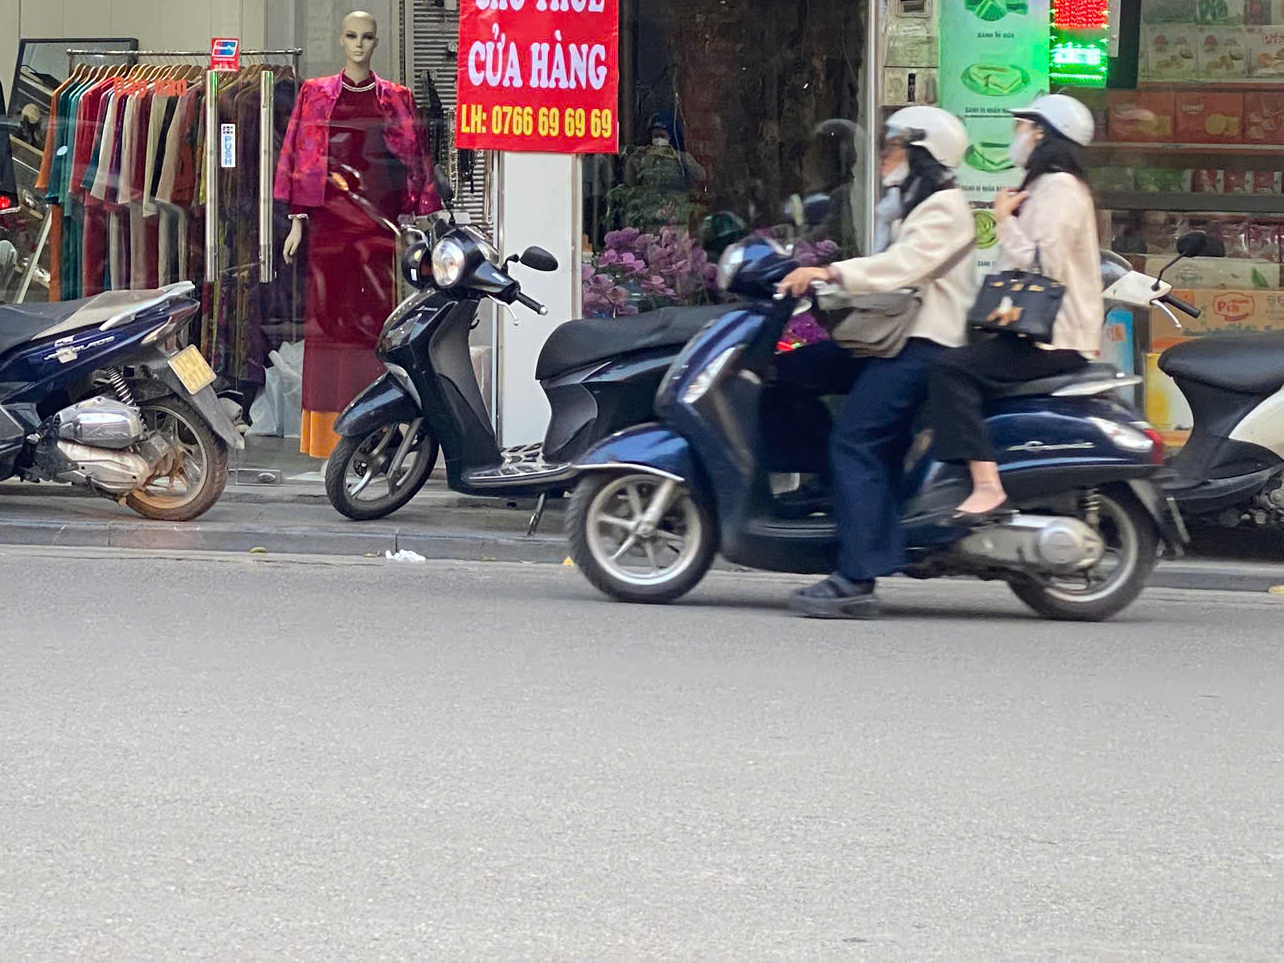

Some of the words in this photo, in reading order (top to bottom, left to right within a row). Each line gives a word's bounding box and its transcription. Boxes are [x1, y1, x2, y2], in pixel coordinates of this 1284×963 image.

[467, 22, 523, 88] CỬA
[529, 29, 608, 90] HÀNG
[460, 103, 488, 134] LH:
[491, 104, 534, 136] 0766
[537, 106, 561, 137] 69
[564, 107, 586, 138] 69
[590, 108, 613, 138] 69
[224, 135, 233, 166] PUSH
